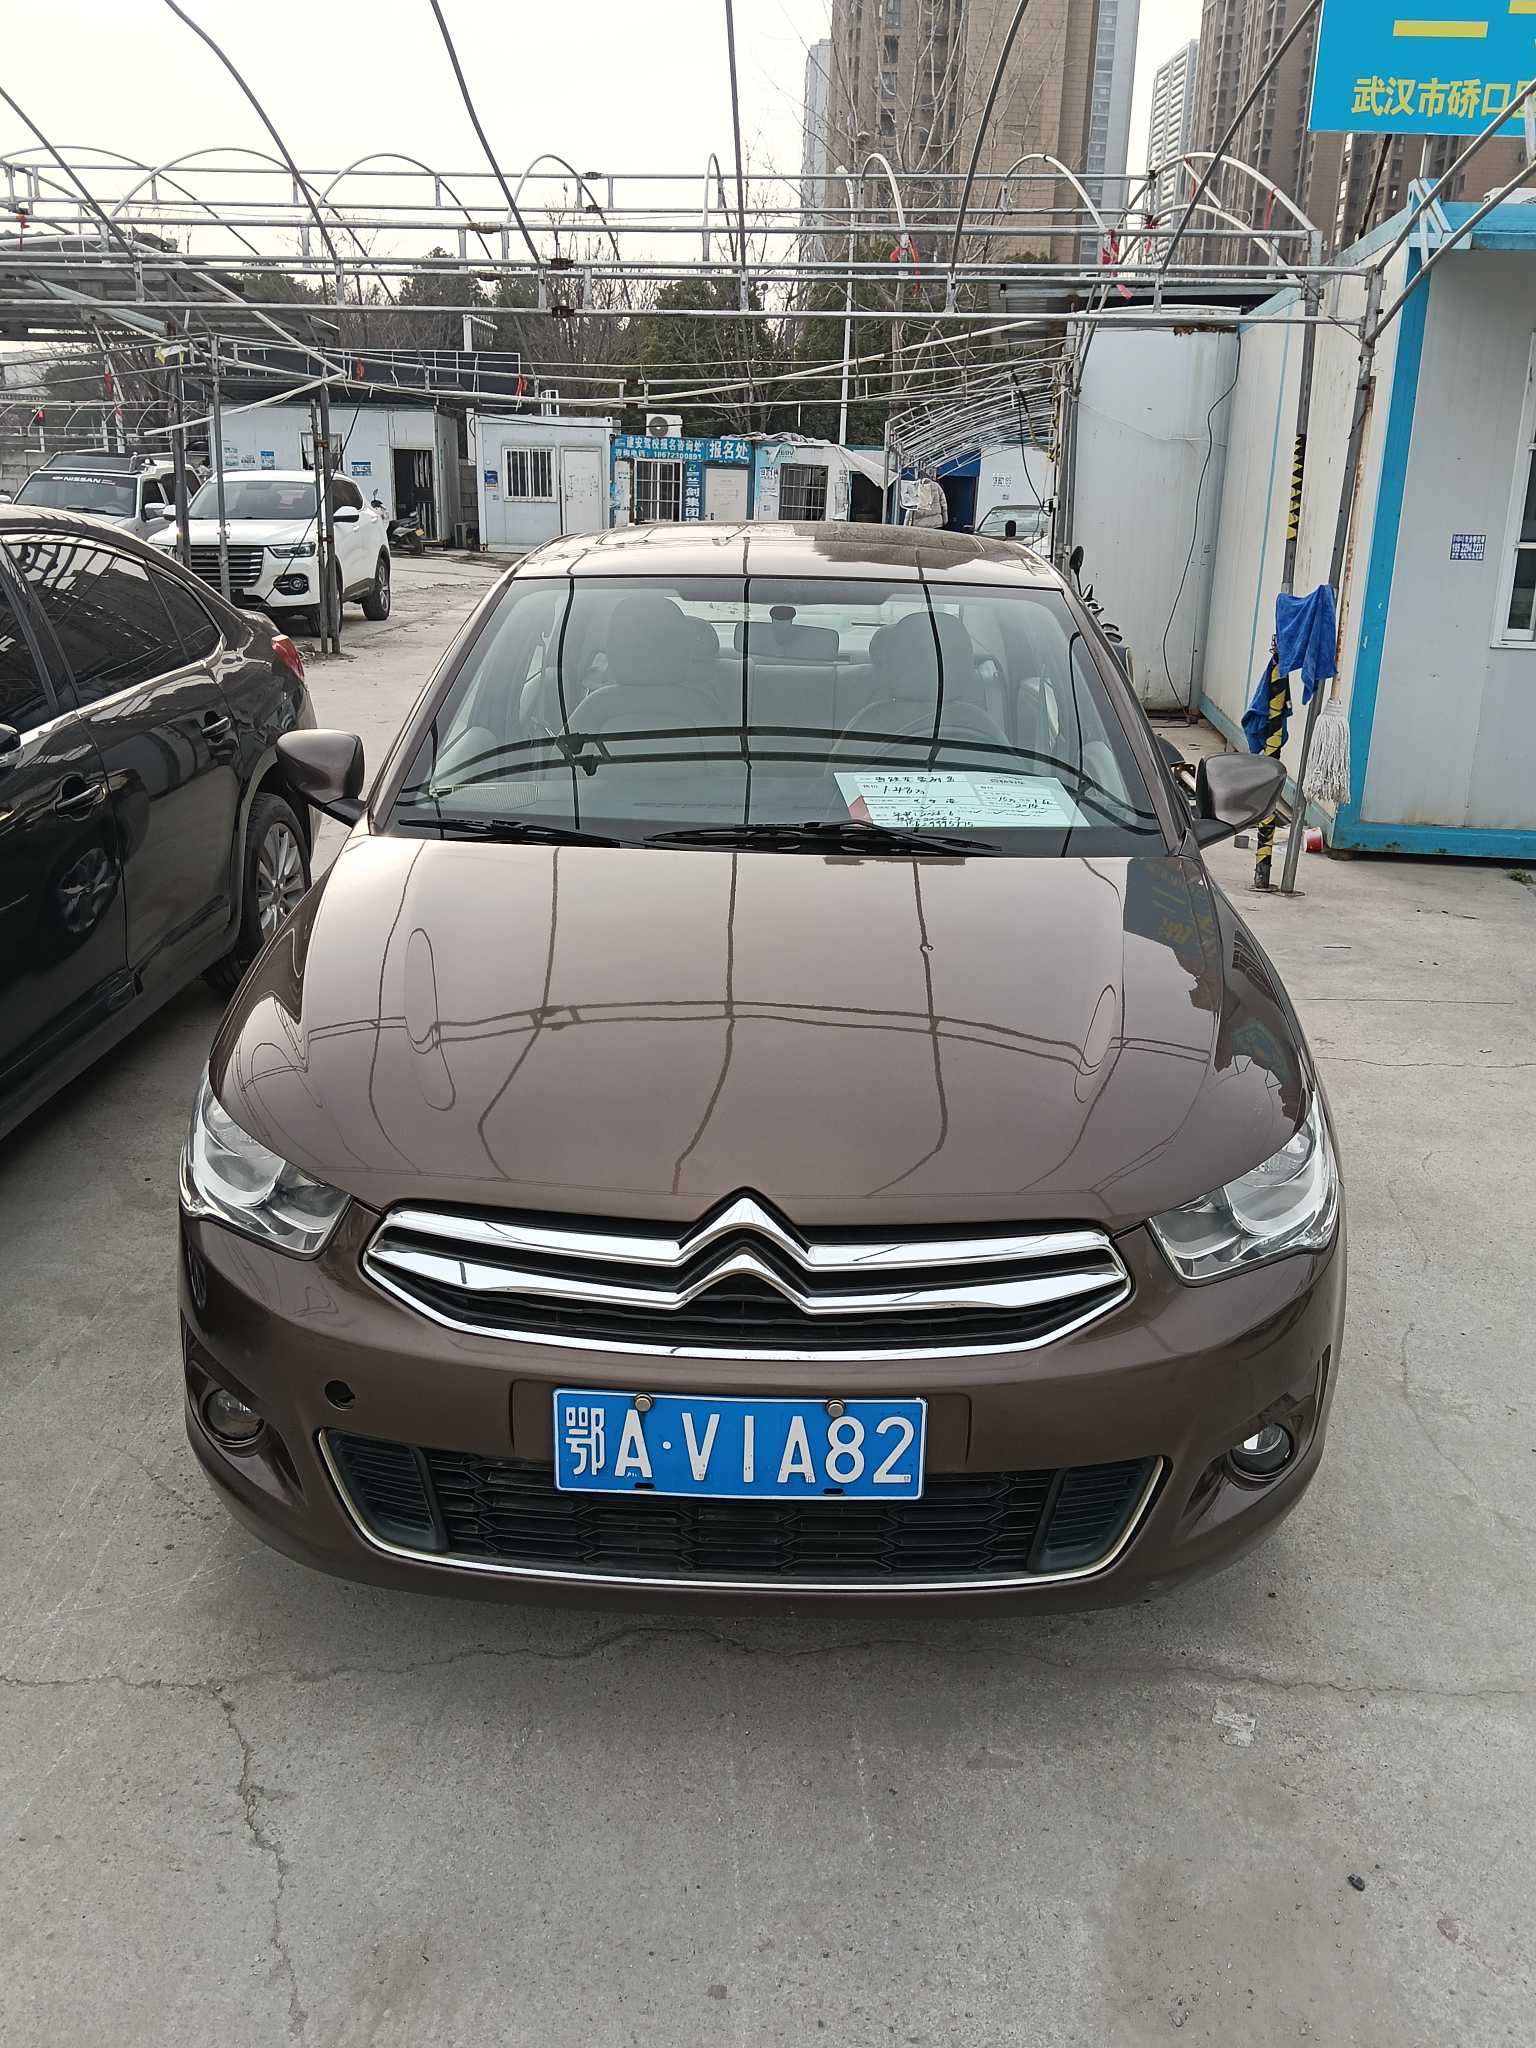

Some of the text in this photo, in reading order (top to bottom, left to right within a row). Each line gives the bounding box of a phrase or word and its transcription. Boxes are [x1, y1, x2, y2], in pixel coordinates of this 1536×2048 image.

[709, 440, 750, 464] 报名处
[63, 476, 102, 484] NISSAN
